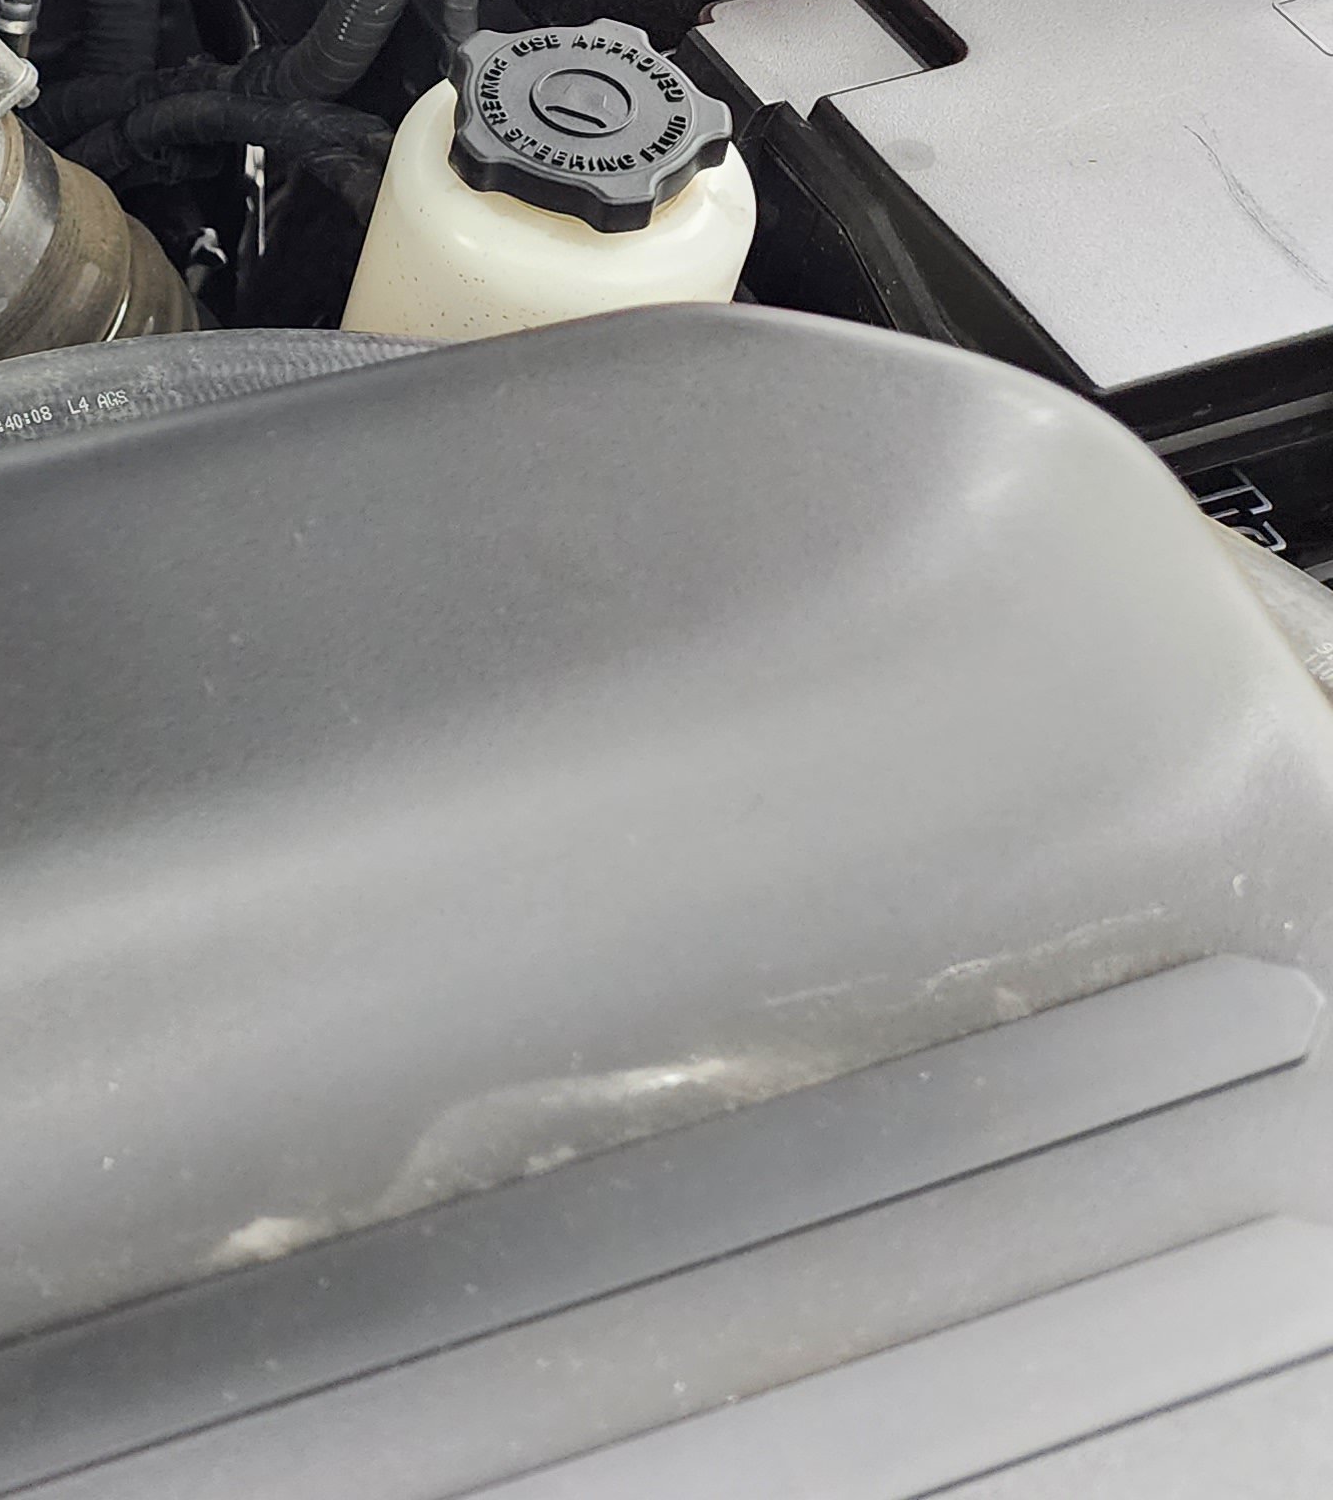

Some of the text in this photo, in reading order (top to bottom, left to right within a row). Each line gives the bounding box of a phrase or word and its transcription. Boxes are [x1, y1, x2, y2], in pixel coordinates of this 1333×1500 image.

[510, 33, 688, 104] USE APPROVED
[476, 57, 689, 173] POWER STEERING FLUID
[66, 396, 91, 416] L4
[96, 389, 129, 410] AGS
